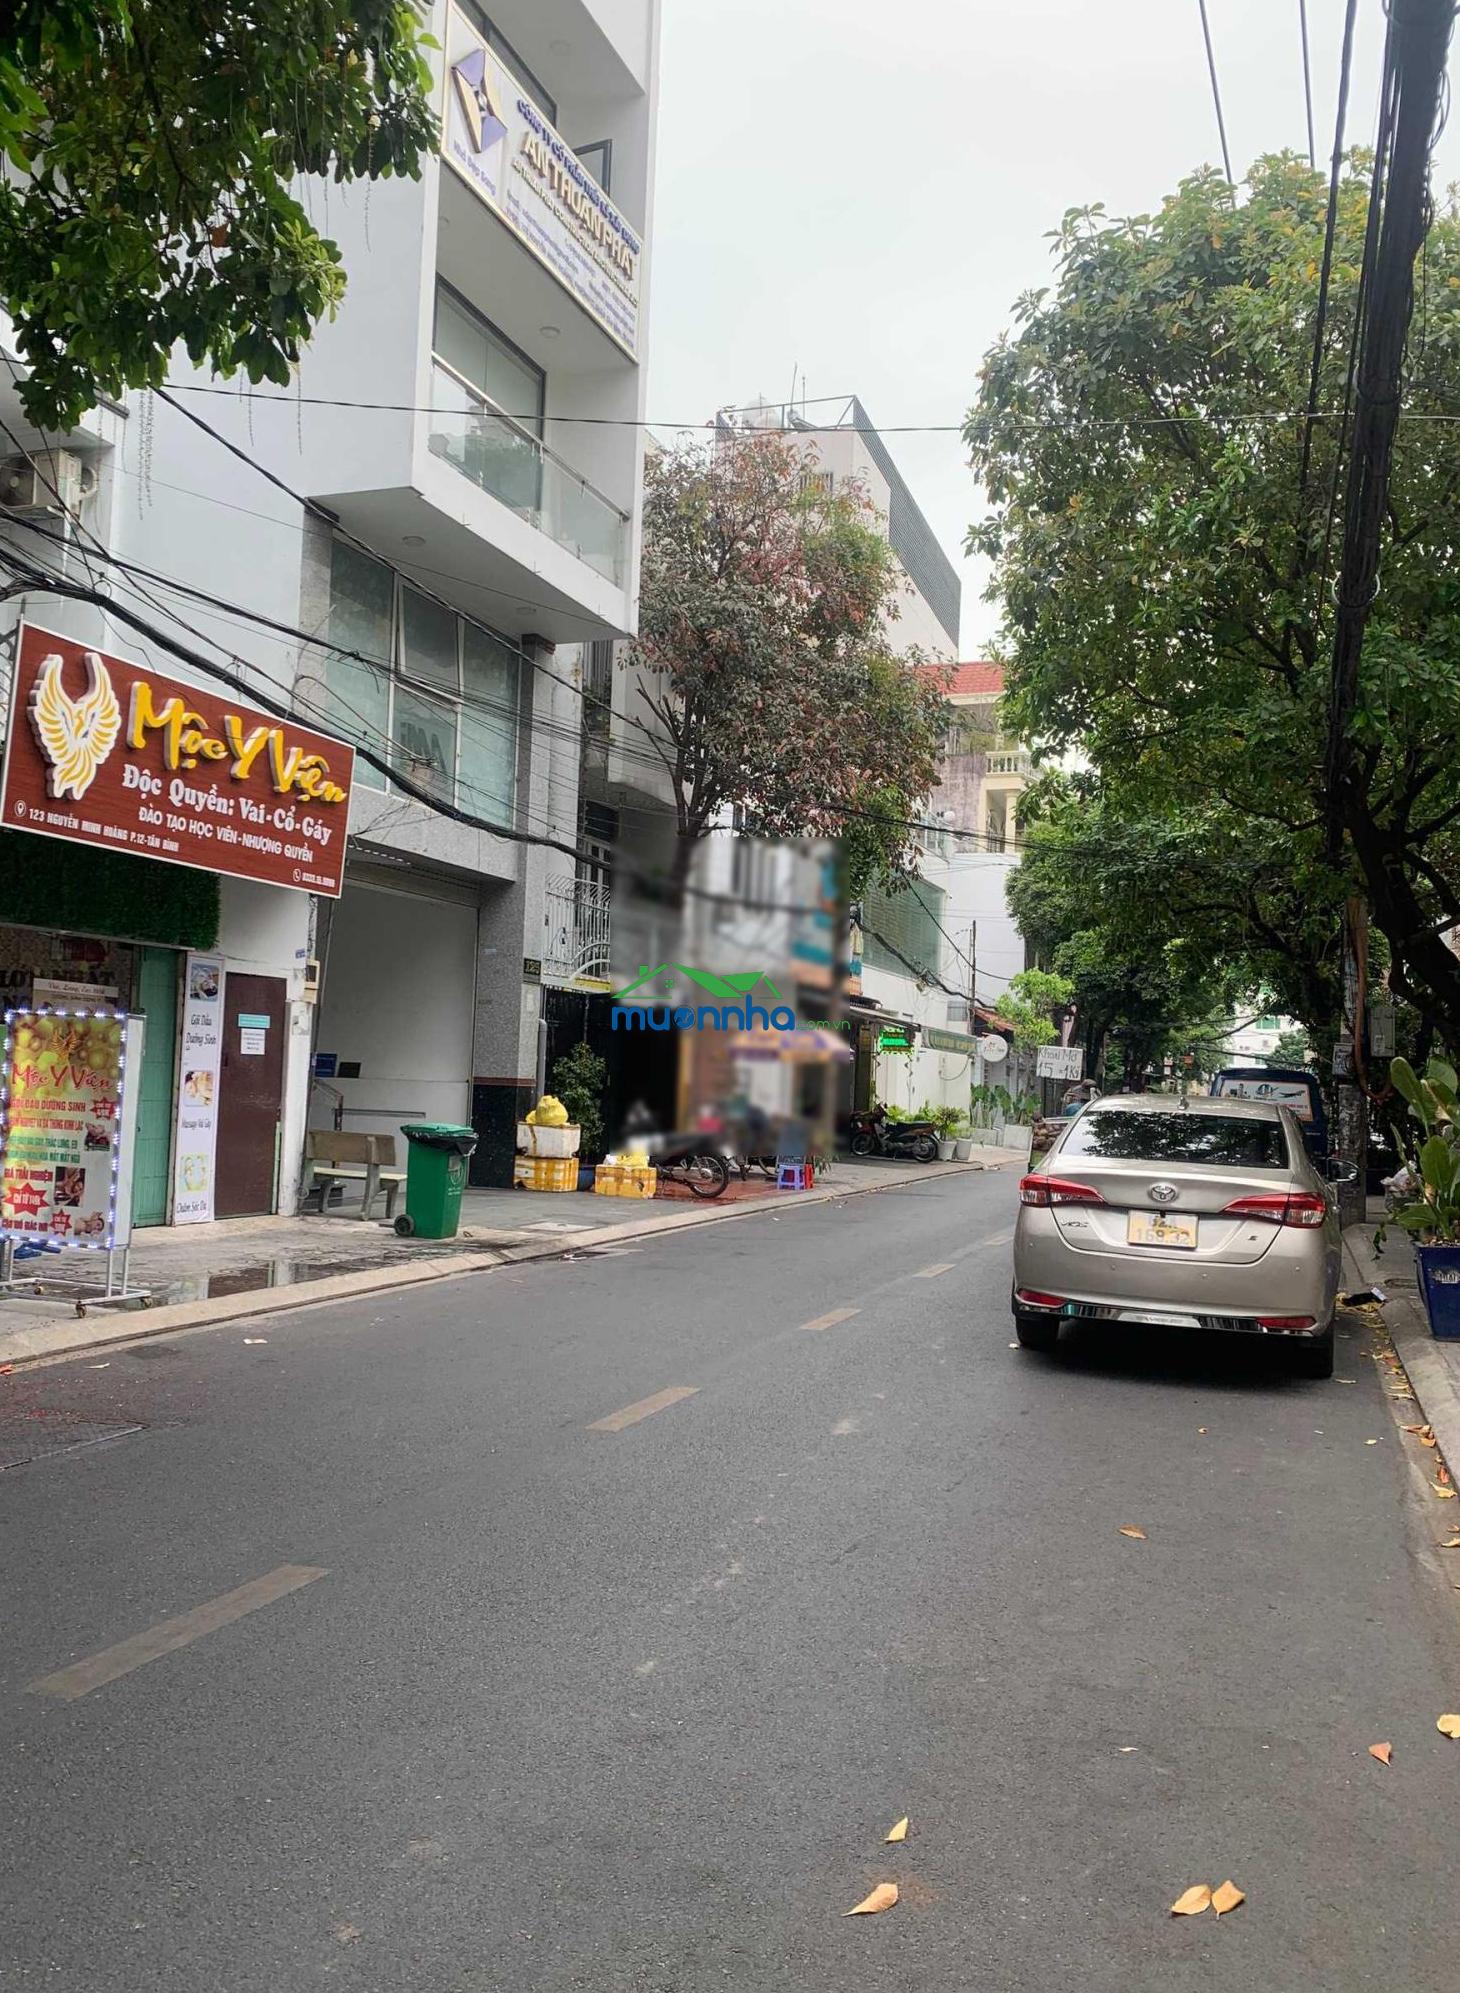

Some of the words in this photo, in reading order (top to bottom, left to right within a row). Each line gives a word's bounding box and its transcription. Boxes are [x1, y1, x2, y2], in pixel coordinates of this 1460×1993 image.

[541, 127, 552, 146] TY
[520, 131, 547, 178] AN
[547, 156, 600, 242] THUẬN
[599, 220, 636, 281] PHÁT
[126, 681, 228, 770] Mộc
[224, 715, 269, 779] Y
[268, 729, 348, 803] Viện
[122, 764, 163, 800] Độc
[168, 778, 235, 816] Quyền:
[29, 808, 45, 822] 123
[138, 803, 163, 827] ĐÀO
[166, 813, 187, 833] TẠO
[188, 819, 213, 840] HỌC
[284, 842, 313, 863] QUYỀN
[50, 1065, 68, 1088] Y
[67, 1101, 86, 1113] SINH
